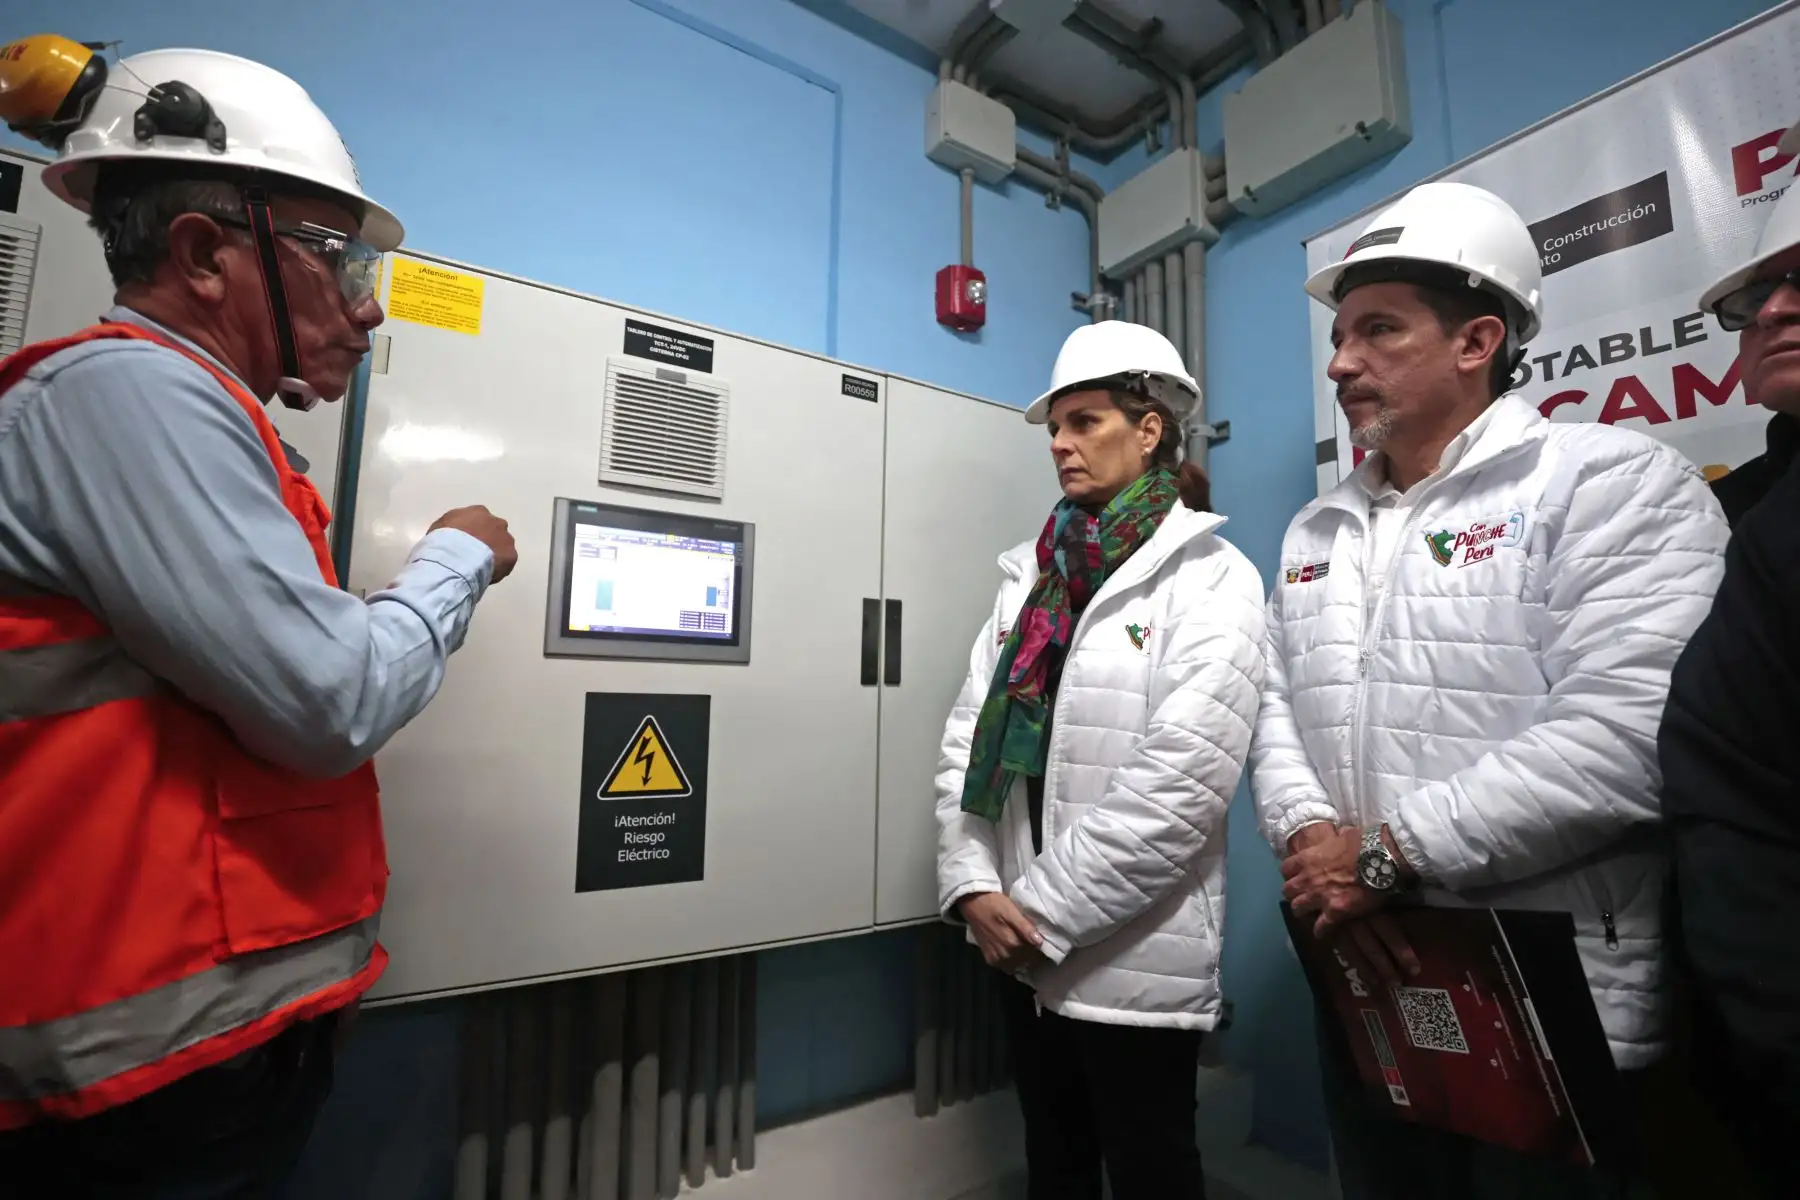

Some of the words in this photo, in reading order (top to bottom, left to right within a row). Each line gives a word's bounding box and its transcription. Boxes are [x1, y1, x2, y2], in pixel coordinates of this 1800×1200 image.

[1731, 127, 1800, 198] P
[1543, 202, 1657, 252] Construcción
[614, 812, 675, 828] ¡Atención!
[624, 831, 666, 847] Riesgo
[617, 846, 670, 863] Eléctrico
